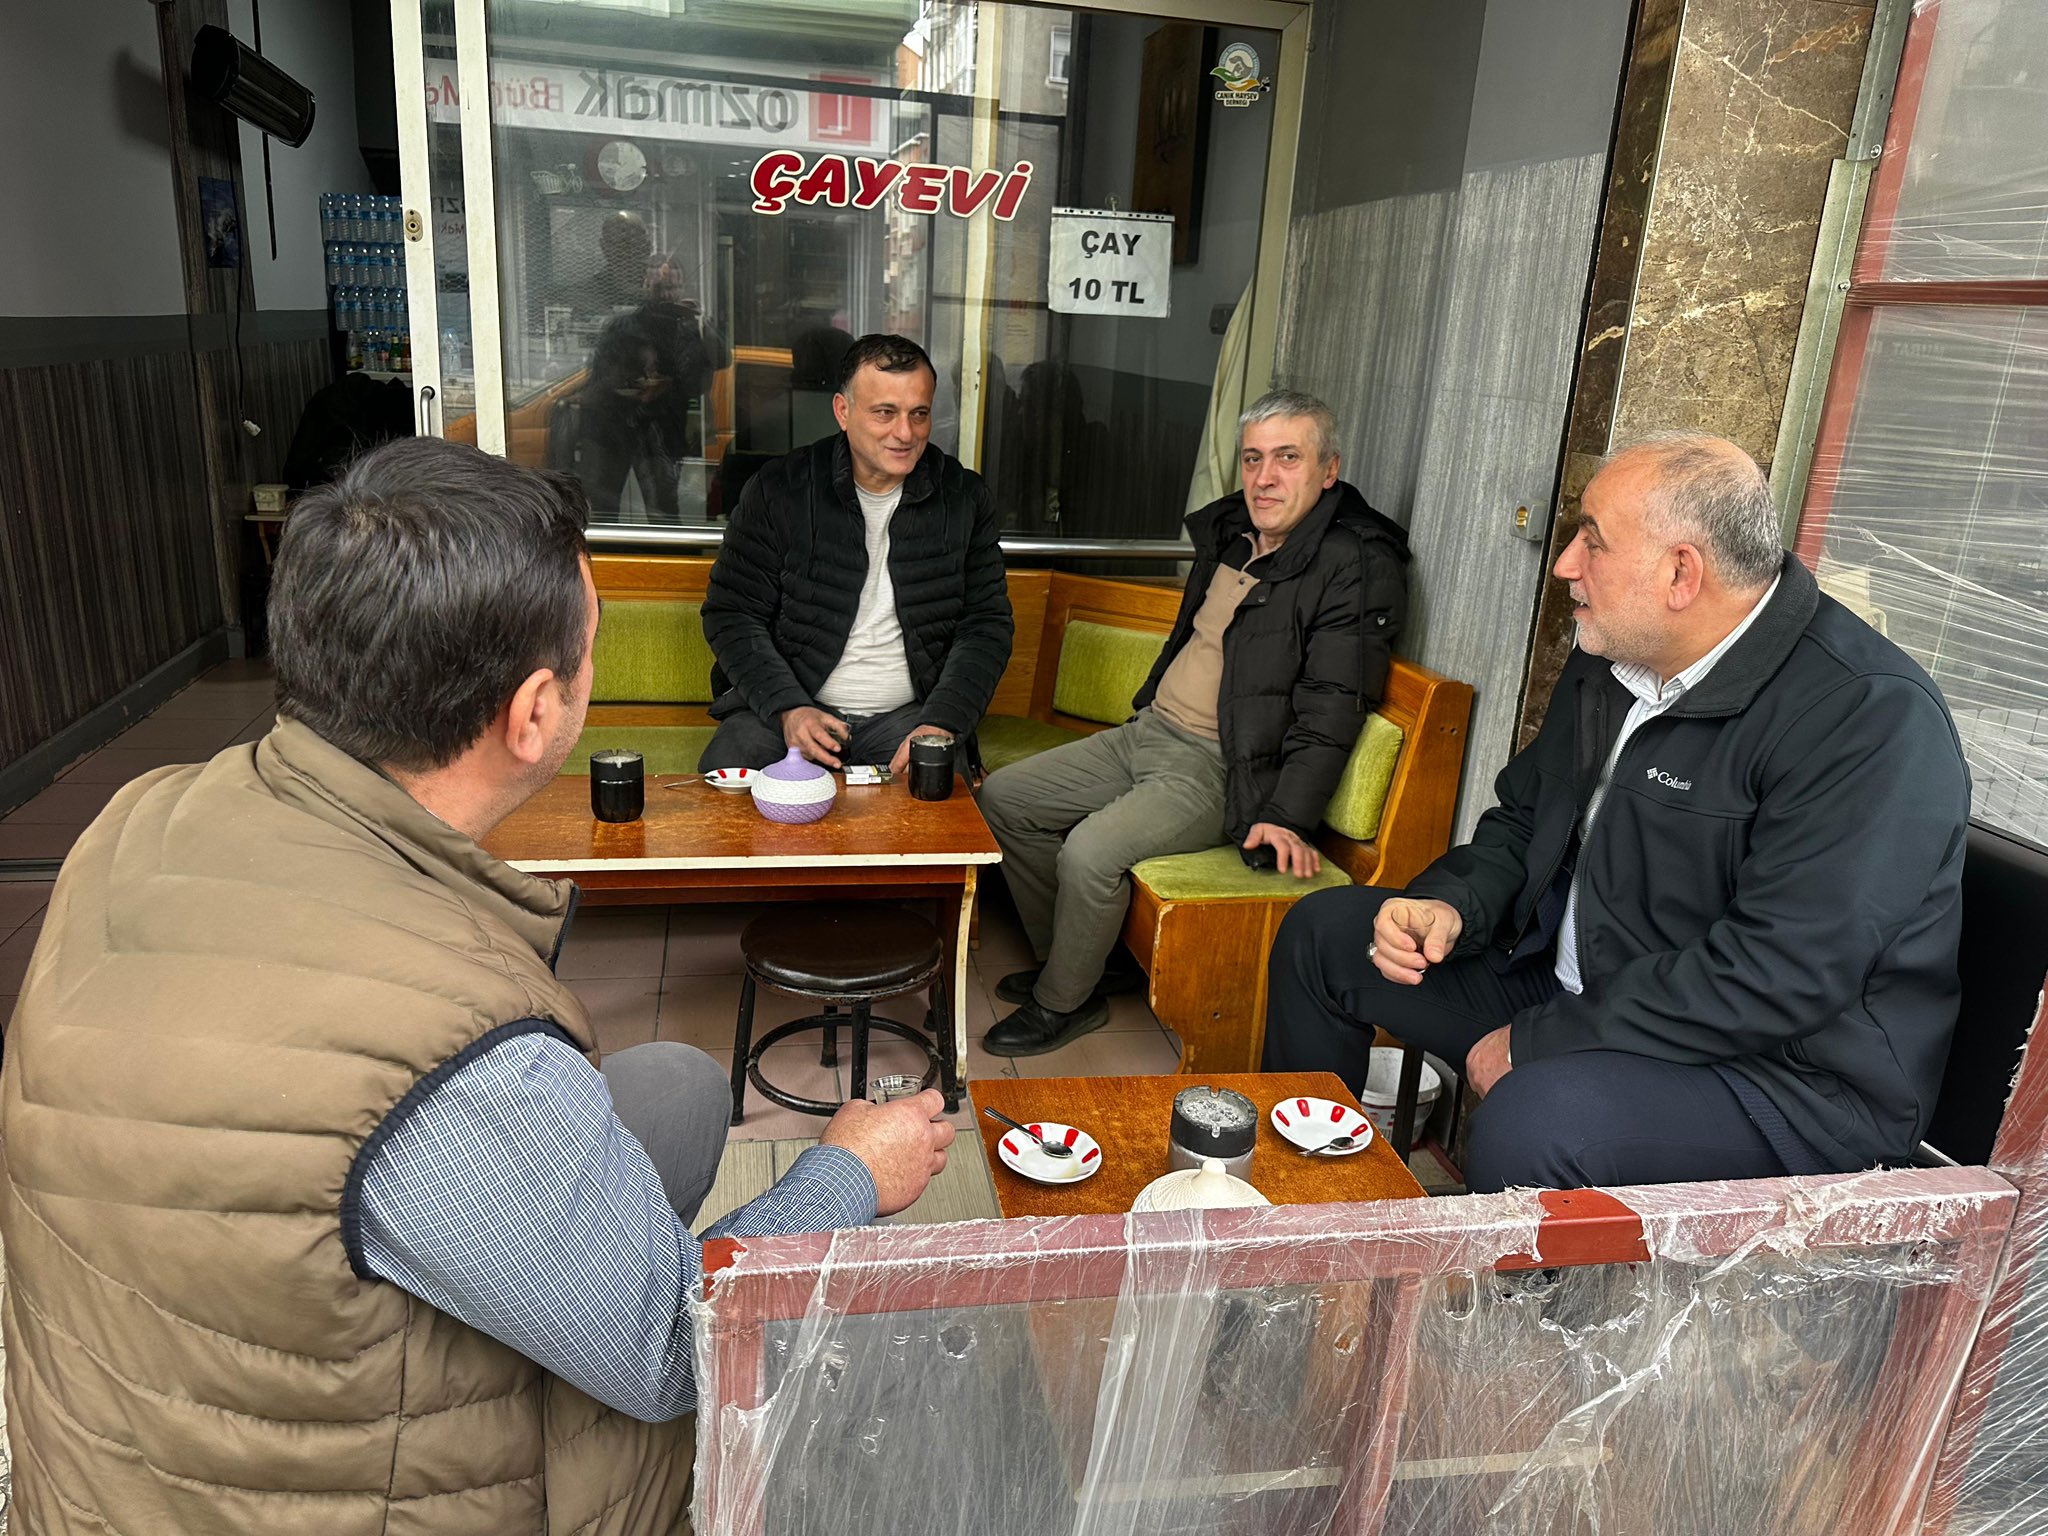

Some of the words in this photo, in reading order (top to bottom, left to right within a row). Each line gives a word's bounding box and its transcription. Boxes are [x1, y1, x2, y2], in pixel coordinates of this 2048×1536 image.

[751, 151, 1033, 221] ÇAYEVİ
[1081, 230, 1142, 258] ÇAY
[1069, 277, 1101, 301] 10
[1111, 280, 1145, 304] TL
